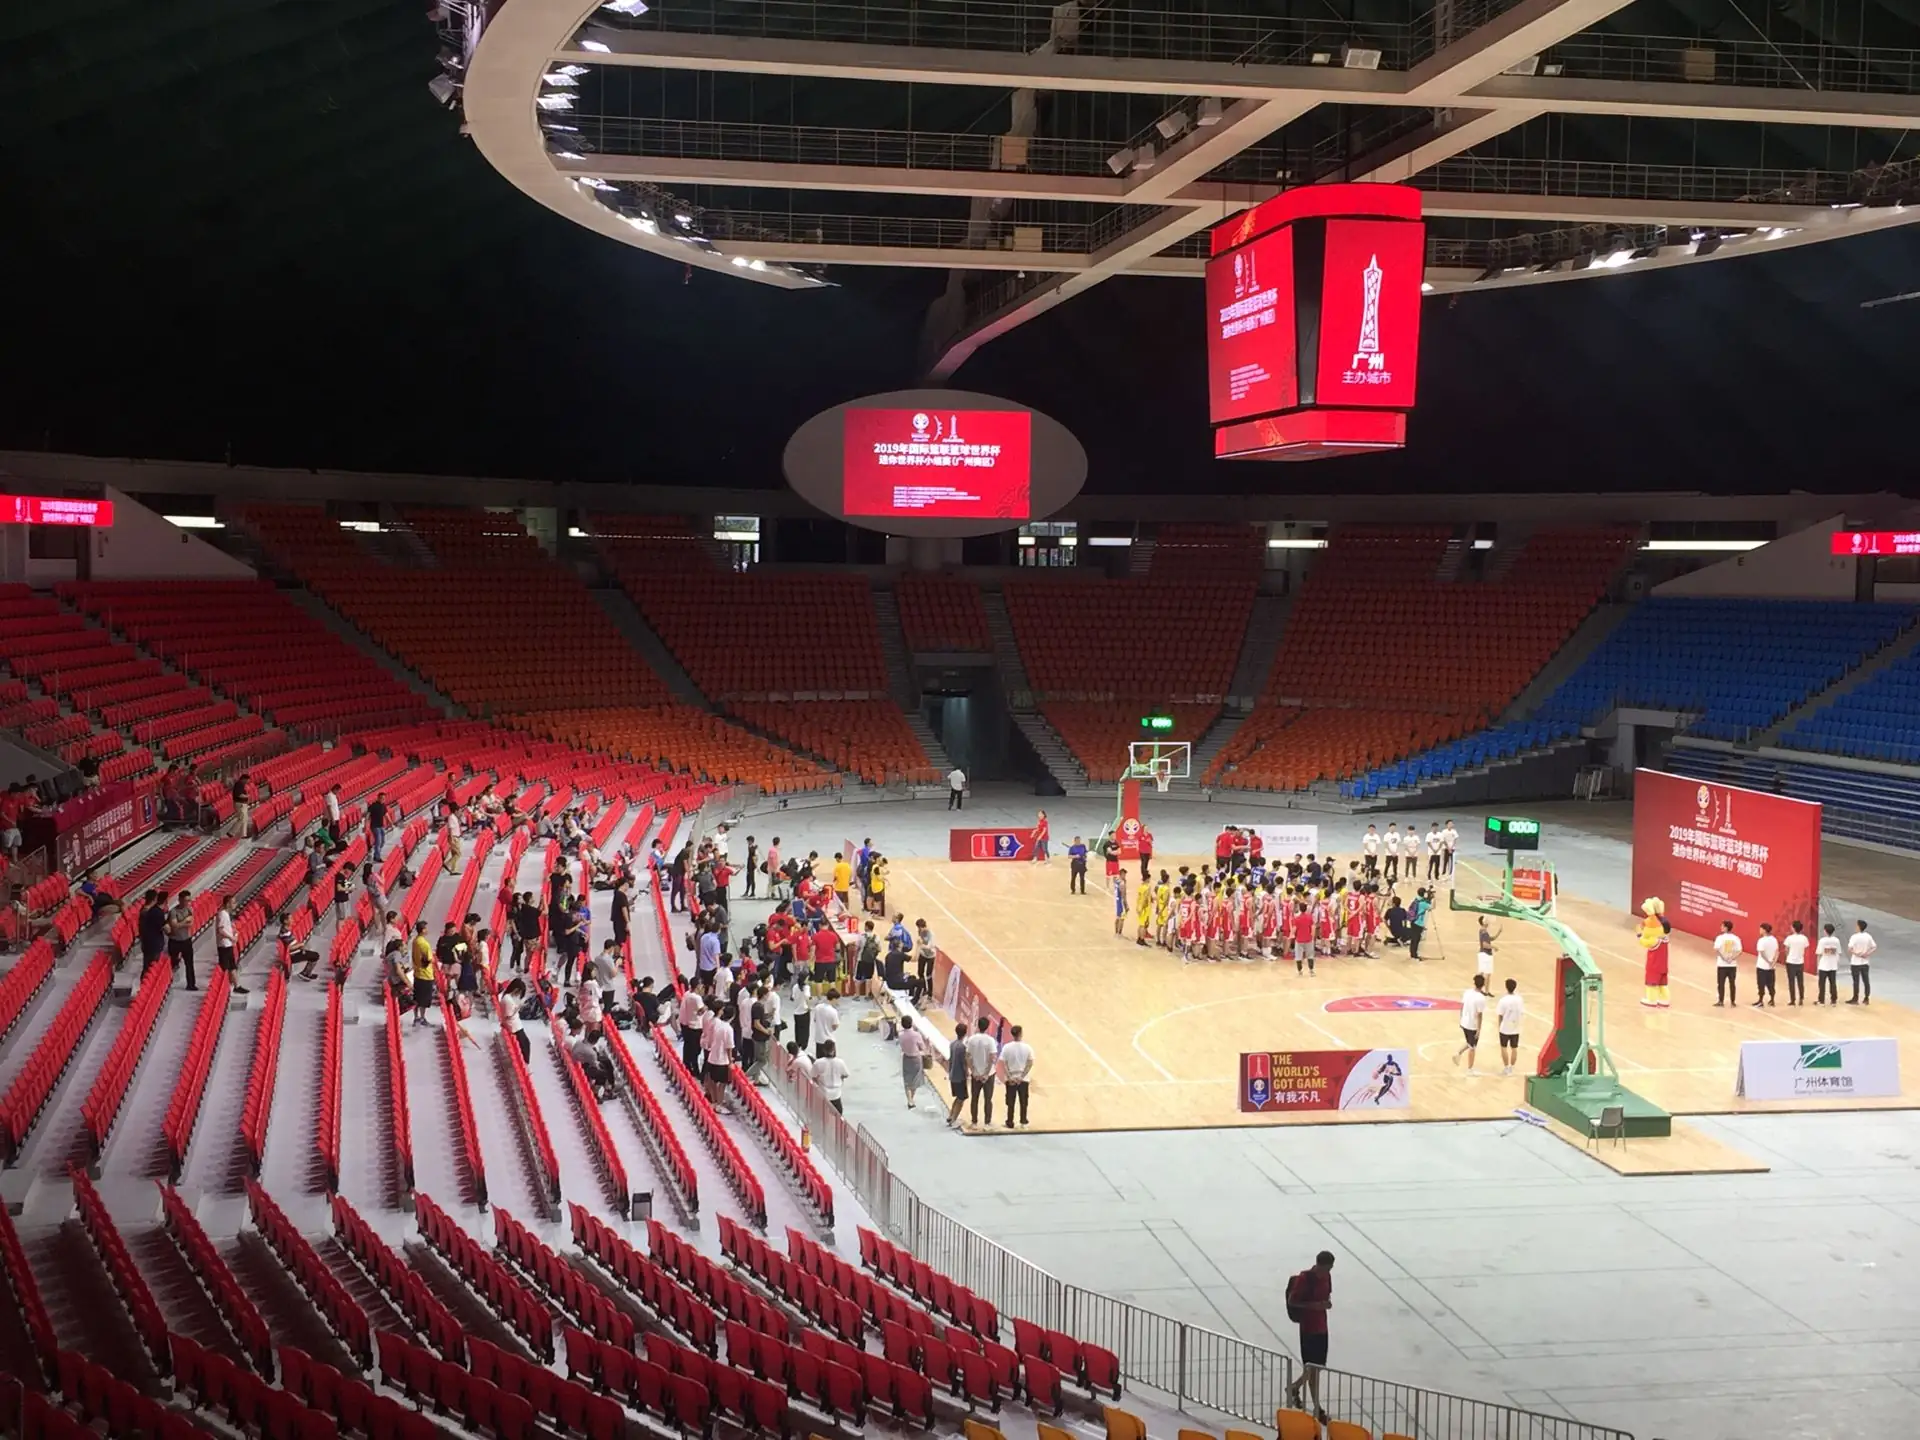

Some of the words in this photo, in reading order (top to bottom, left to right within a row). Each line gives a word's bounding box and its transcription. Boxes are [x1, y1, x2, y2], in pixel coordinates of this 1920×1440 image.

[1351, 352, 1384, 370] 广州
[1342, 370, 1392, 384] 主办城市
[1737, 556, 1745, 567] E
[1272, 1054, 1292, 1065] THE
[1272, 1066, 1320, 1077] WORLD'S
[1273, 1079, 1294, 1090] GOT
[1296, 1078, 1328, 1089] GAME
[1794, 1076, 1853, 1089] 广州体育馆
[1275, 1091, 1321, 1104] 有我不凡
